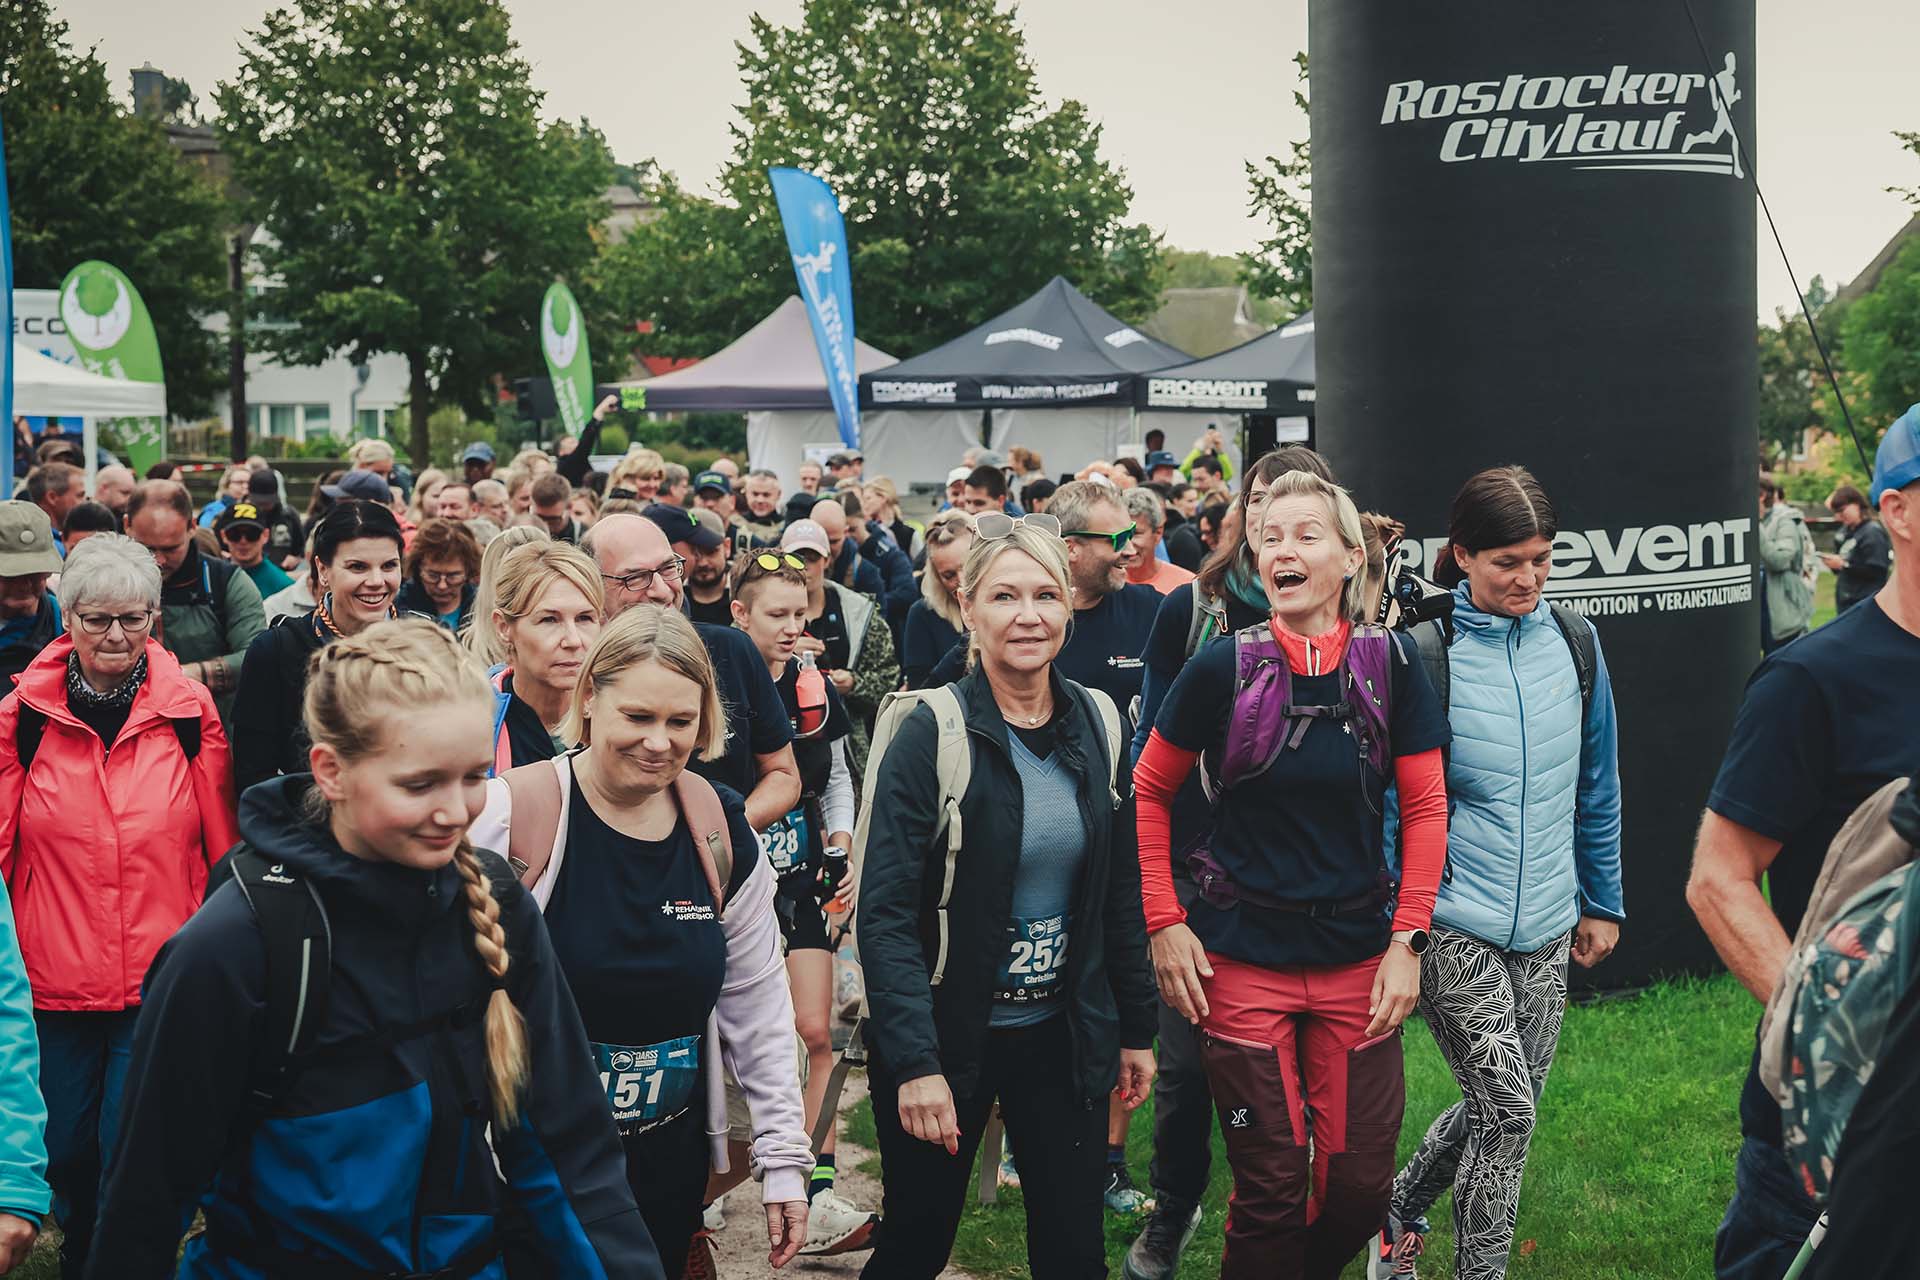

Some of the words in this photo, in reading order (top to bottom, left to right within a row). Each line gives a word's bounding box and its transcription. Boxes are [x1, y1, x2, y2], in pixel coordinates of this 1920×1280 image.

[1381, 65, 1705, 125] Rostocker
[1440, 111, 1686, 163] Citylauf
[1380, 592, 1389, 618] LEKI
[1008, 933, 1069, 974] 252
[612, 1108, 641, 1121] elanie
